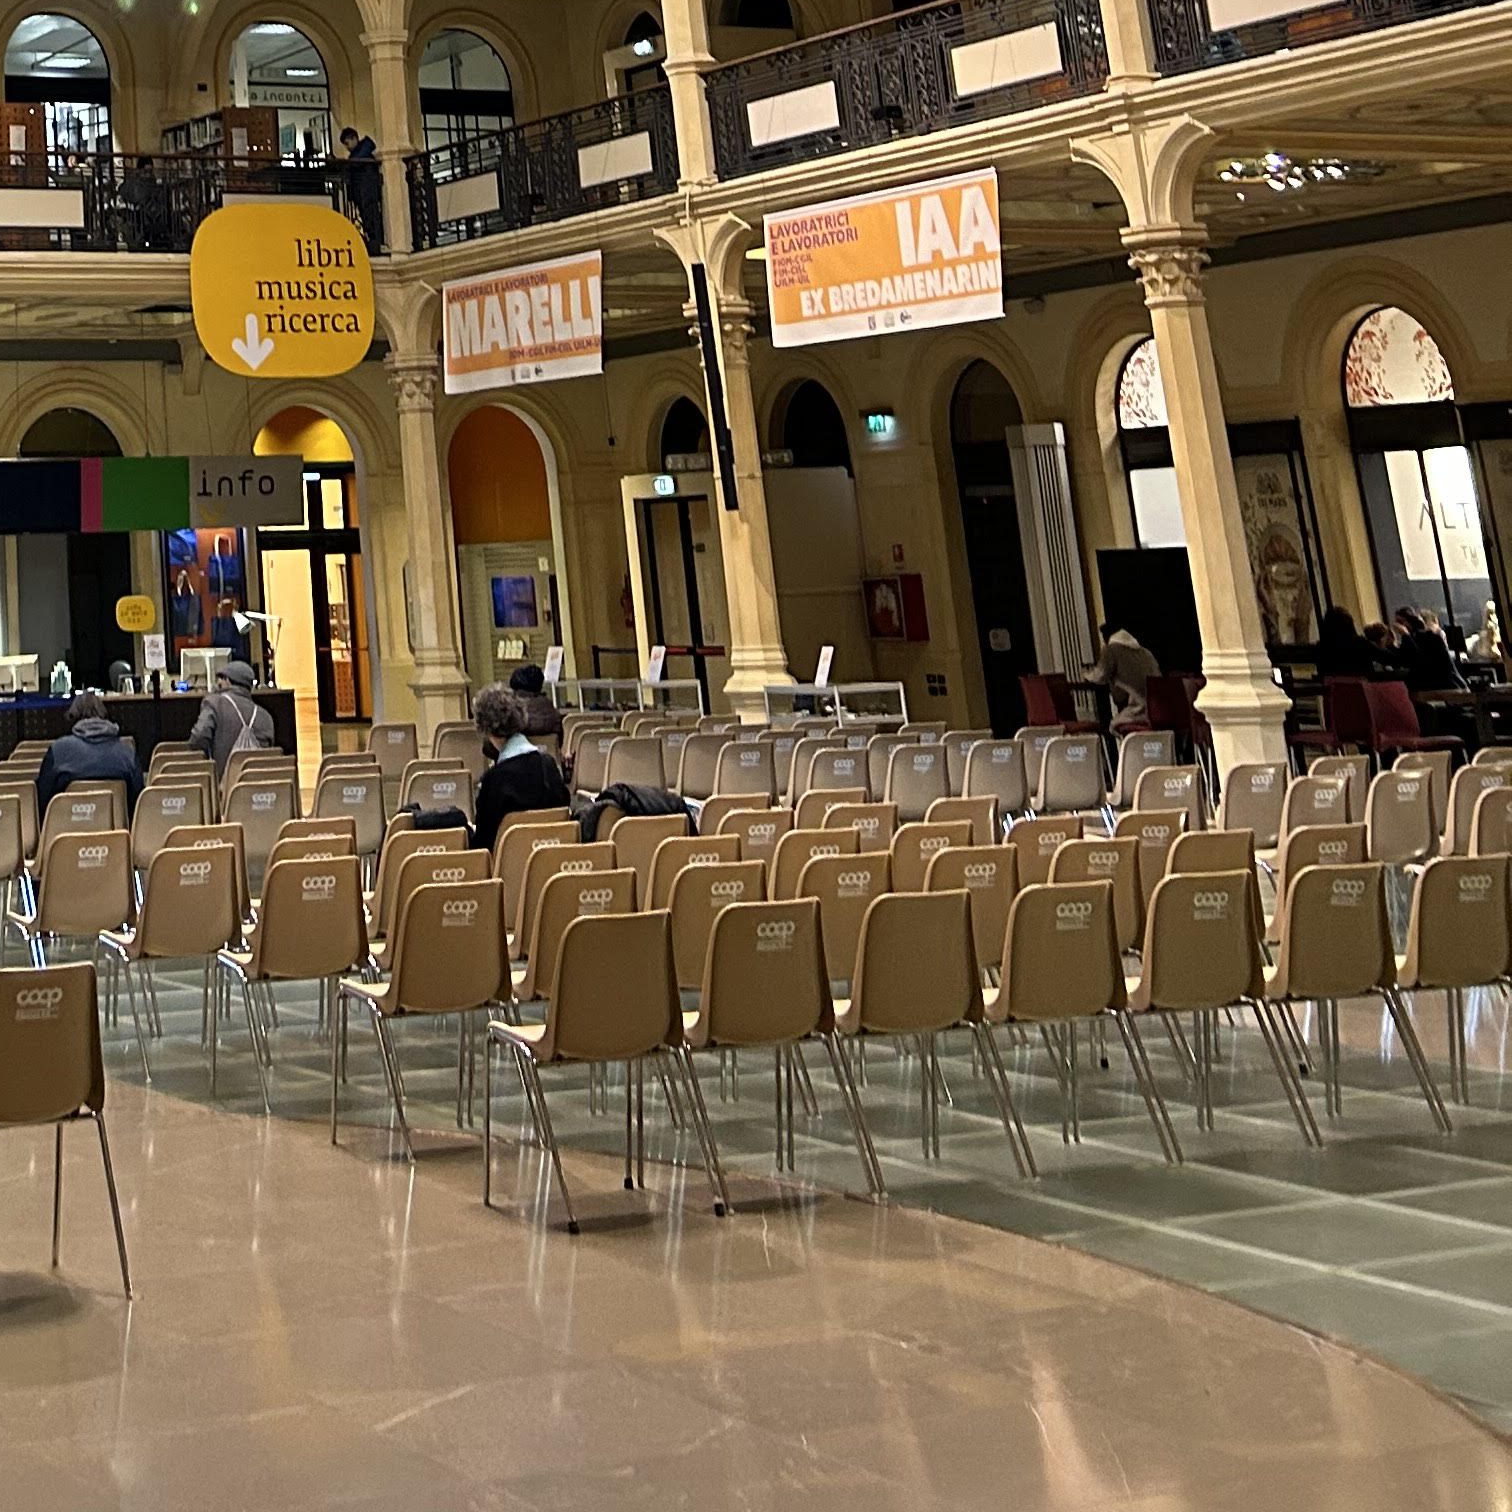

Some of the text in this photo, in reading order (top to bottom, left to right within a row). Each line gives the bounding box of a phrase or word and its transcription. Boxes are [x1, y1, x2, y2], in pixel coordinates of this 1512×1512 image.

[769, 210, 850, 240] LAVORATRICI
[894, 184, 1000, 268] IAA
[771, 226, 859, 255] E LAVORATORI
[295, 239, 356, 268] libri
[256, 272, 358, 301] musica
[800, 258, 1002, 318] EX BREDAMENARINI
[266, 306, 361, 334] ricerca
[448, 275, 601, 359] MARELLI
[197, 469, 275, 497] info
[1089, 851, 1119, 865] coop
[180, 862, 211, 877] coop
[433, 867, 465, 881] coop
[965, 864, 996, 878] coop
[303, 876, 336, 893] coop
[838, 873, 870, 887] coop
[1332, 879, 1365, 894] coop
[1460, 875, 1491, 890] coop
[579, 889, 613, 905] coop
[711, 882, 744, 896] coop
[1194, 892, 1228, 907] coop
[443, 900, 478, 917] coop
[1057, 903, 1091, 918] coop
[757, 921, 795, 938] coop
[17, 987, 62, 1008] coop
